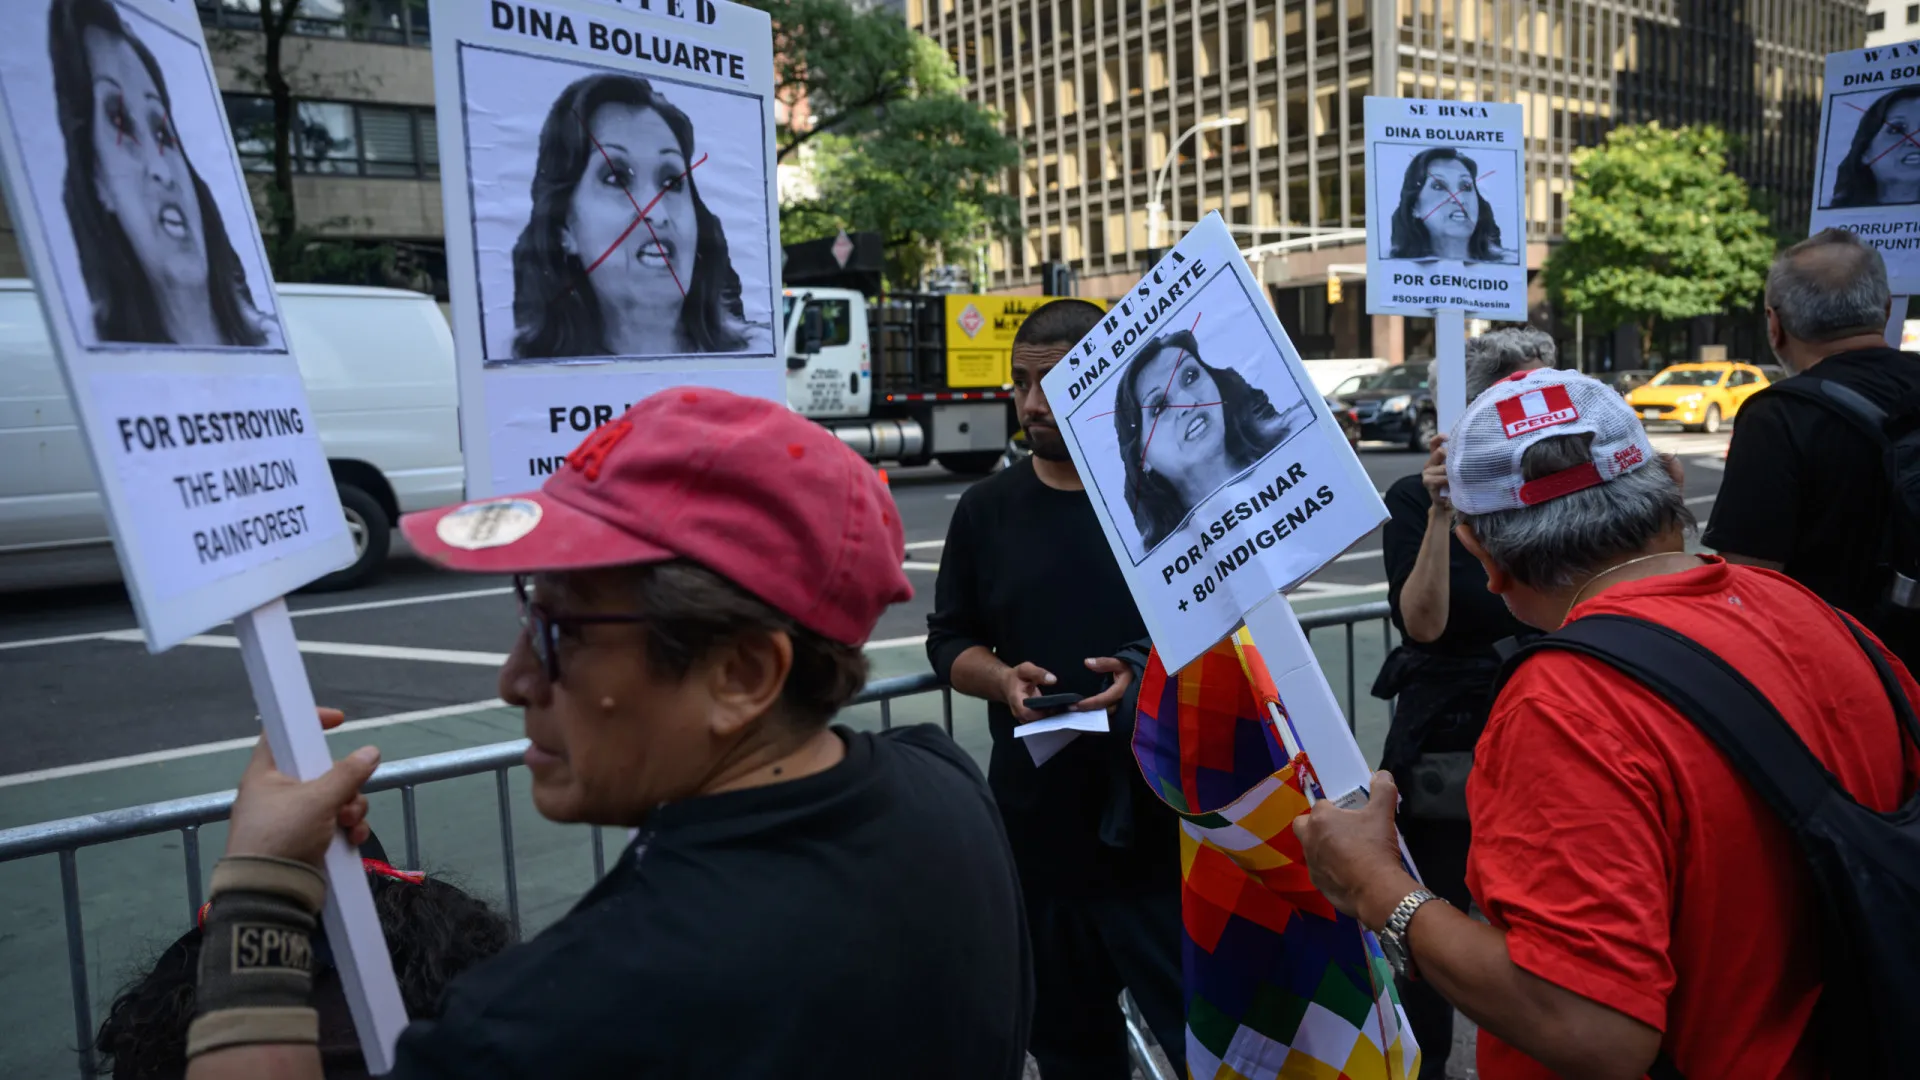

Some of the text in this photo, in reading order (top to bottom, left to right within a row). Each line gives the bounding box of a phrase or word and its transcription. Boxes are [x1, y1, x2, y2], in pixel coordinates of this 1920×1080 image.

[491, 0, 745, 80] DINA BOLUARTE
[1843, 70, 1885, 86] DINA
[1409, 104, 1489, 118] SE BUSCA
[1385, 126, 1505, 143] DINA BOLUARTE
[1392, 294, 1447, 304] #SOSPERU
[1393, 273, 1509, 291] POR GENOCIDIO
[1067, 258, 1207, 401] DINA BOLUARTE
[1069, 250, 1186, 372] SE BUSCA
[117, 407, 304, 453] FOR DESTROYING
[549, 404, 613, 433] FOR
[1513, 410, 1567, 432] PERU
[173, 458, 298, 509] THE AMAZON
[193, 504, 309, 565] RAINFOREST
[1161, 462, 1308, 586] POR ASESINAR
[1192, 575, 1216, 603] 80
[1214, 485, 1334, 583] INDIGENAS
